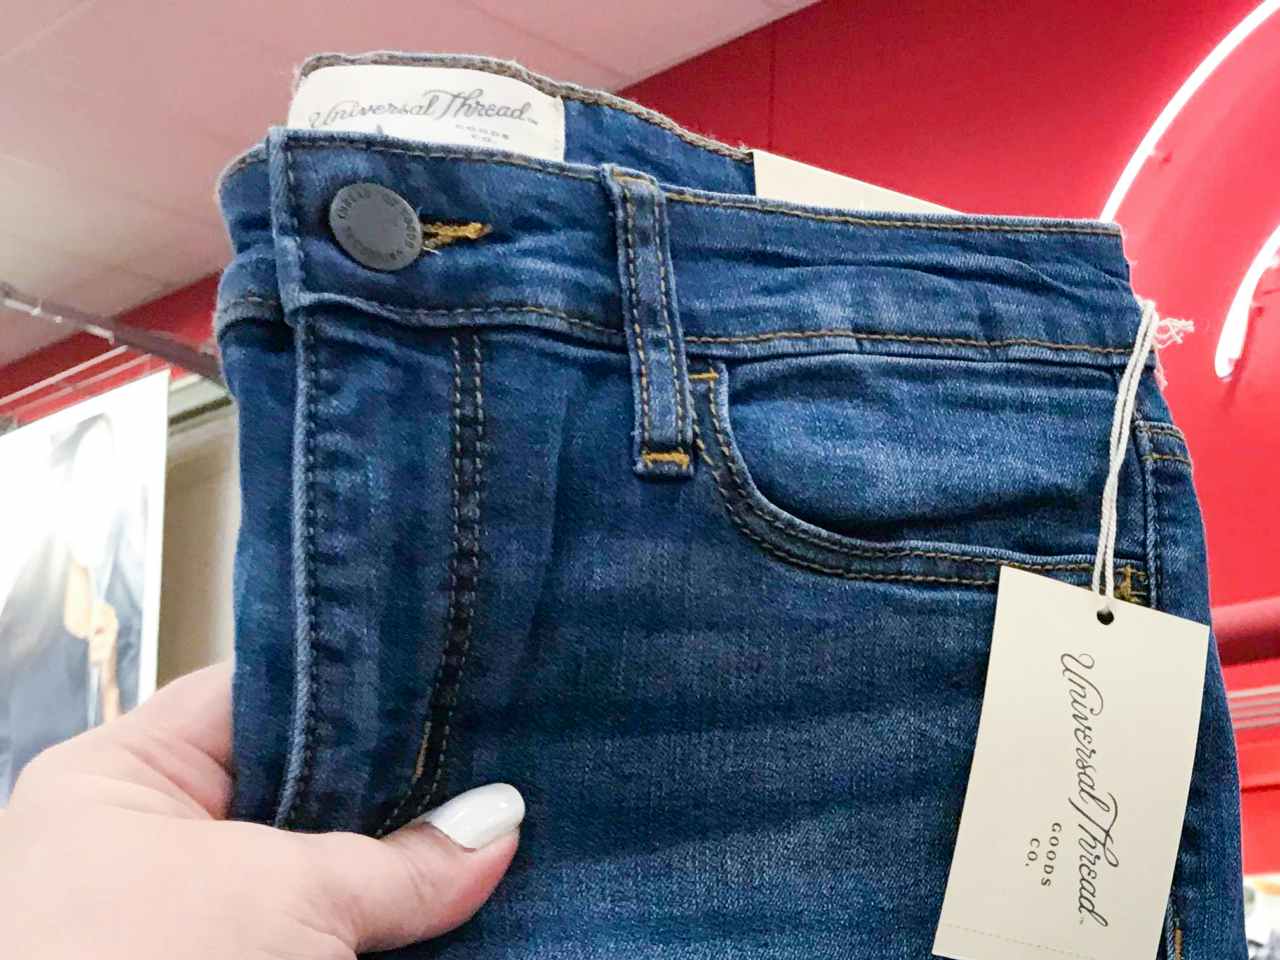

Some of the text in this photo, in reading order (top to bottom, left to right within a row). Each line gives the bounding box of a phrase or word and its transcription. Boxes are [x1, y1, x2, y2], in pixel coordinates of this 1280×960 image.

[308, 88, 527, 128] Universal Thread
[1060, 653, 1120, 928] Universal Thread
[1025, 837, 1041, 868] CO.
[1040, 822, 1063, 888] GOODS
